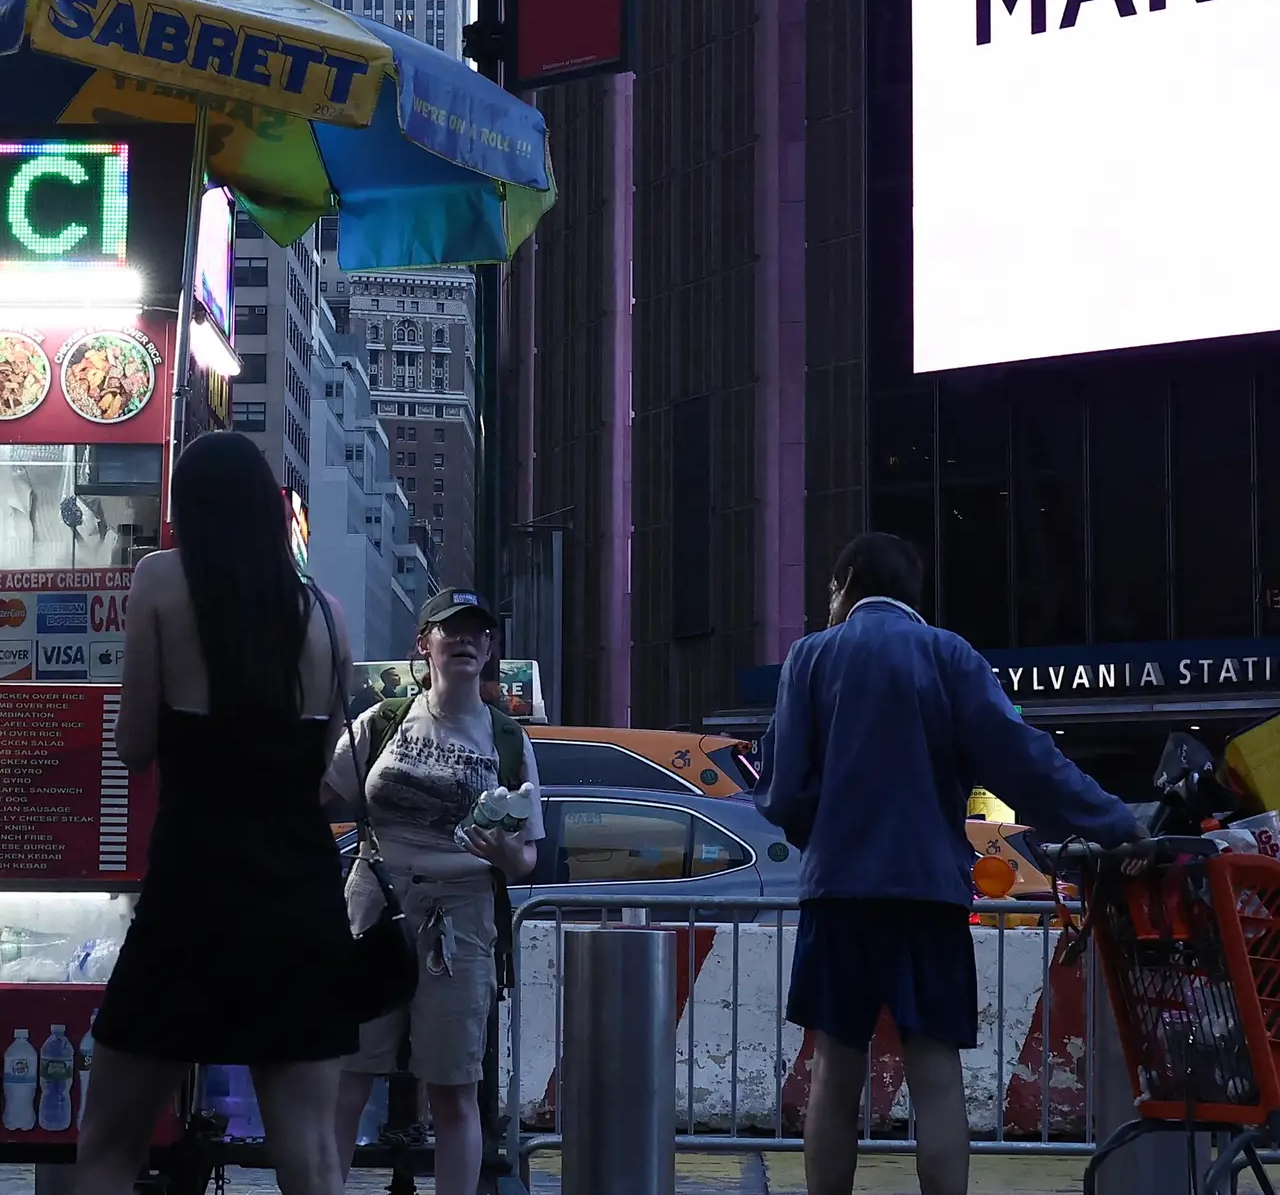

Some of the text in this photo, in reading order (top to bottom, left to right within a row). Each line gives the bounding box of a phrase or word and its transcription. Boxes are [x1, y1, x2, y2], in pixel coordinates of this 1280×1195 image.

[480, 127, 511, 152] ROLL
[146, 339, 163, 366] RICE
[6, 572, 54, 589] ACCEPT
[57, 572, 103, 588] CREDIT
[105, 571, 134, 587] CAR
[36, 603, 89, 627] AMERICAN EXPRESS
[41, 644, 86, 666] VISA
[31, 692, 60, 701] OVER
[61, 692, 85, 701] RICE
[14, 702, 44, 710] OVER
[45, 702, 69, 710] RICE
[31, 720, 60, 729] OVER
[61, 720, 85, 729] RICE
[8, 730, 37, 738] OVER
[38, 730, 63, 738] RICE
[30, 739, 65, 747] SALAD
[13, 749, 48, 757] SALAD
[29, 758, 60, 766] GYRO
[2, 777, 32, 785] GYRO
[29, 787, 84, 795] SANDWICH
[22, 805, 71, 814] SAUSAGE
[18, 814, 59, 823] CHEESE
[61, 814, 95, 823] STEAK
[23, 843, 66, 851] BURGER
[27, 852, 63, 860] KEBAB
